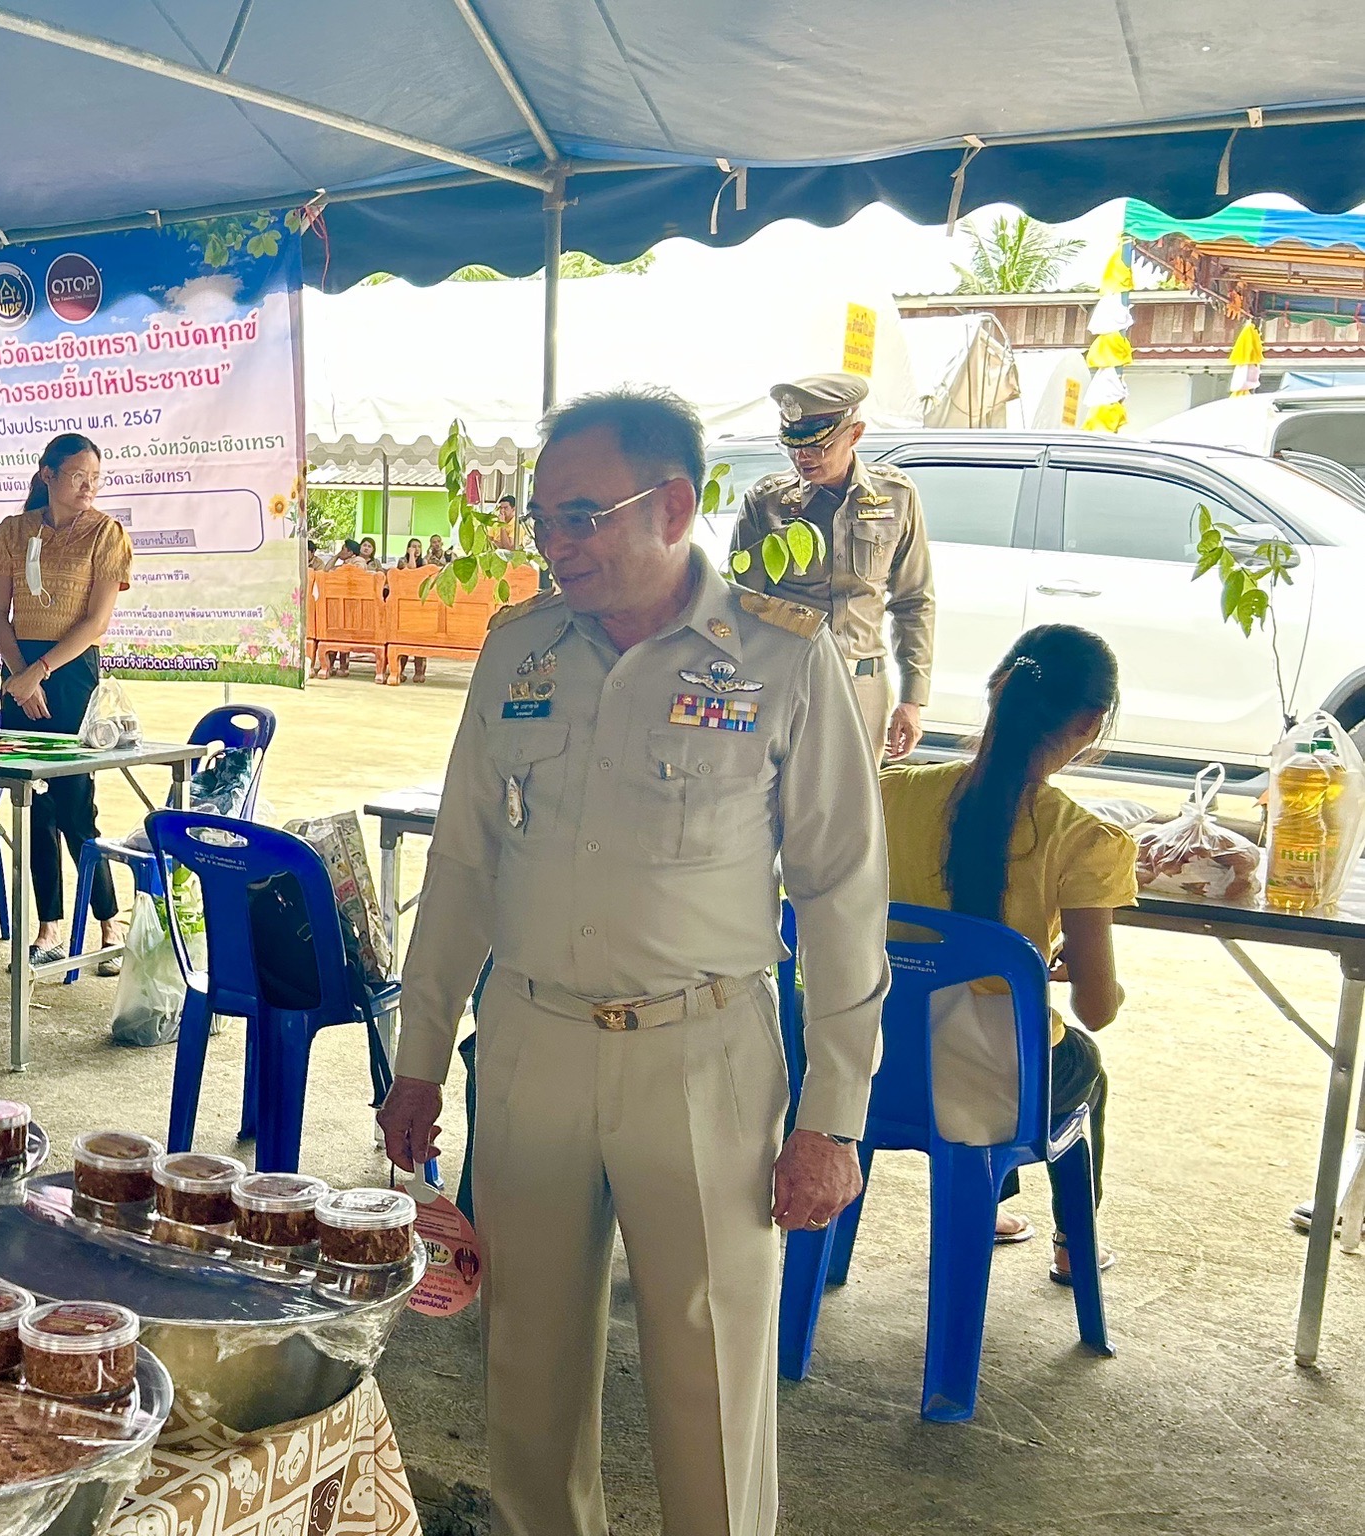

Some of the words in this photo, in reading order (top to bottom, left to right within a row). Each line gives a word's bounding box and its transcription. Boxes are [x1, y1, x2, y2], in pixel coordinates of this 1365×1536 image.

[51, 275, 96, 295] OTOP
[146, 312, 258, 349] บำบัดทุกข์
[87, 413, 118, 429] พ.ศ.
[123, 408, 162, 427] 2567
[103, 435, 285, 460] อ.สว.จังหวัดฉะเชิงเทรา
[104, 469, 191, 486] วัดฉะเชิงเทรา
[132, 569, 190, 585] นาคุณภาพชีวิต
[113, 604, 264, 621] จัดการหนี้ของกองทุนพัฒนาบทบาทสตรี
[925, 959, 935, 967] 21
